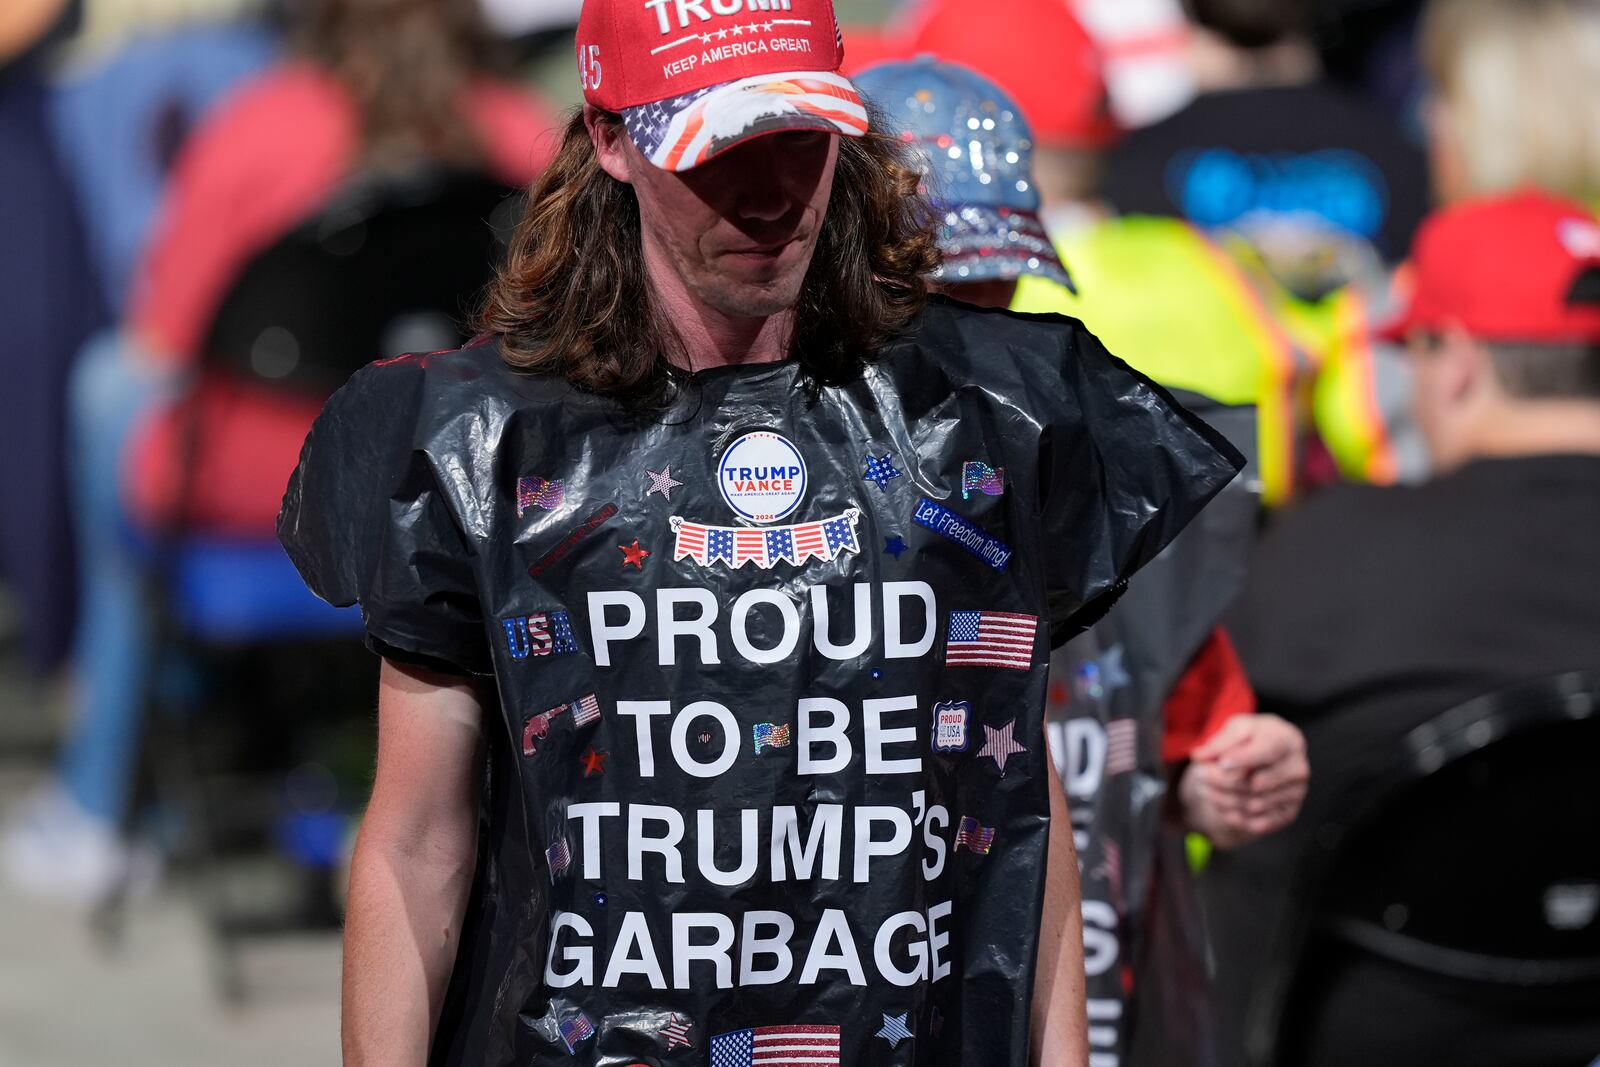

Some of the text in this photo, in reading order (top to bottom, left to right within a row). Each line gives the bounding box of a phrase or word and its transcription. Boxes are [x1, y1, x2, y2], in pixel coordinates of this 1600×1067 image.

[578, 44, 602, 90] 45
[663, 38, 811, 79] KEEP AMERICA GREAT!
[725, 466, 800, 481] TRUMP
[734, 480, 793, 492] VANCE
[915, 502, 1012, 567] Let Freedom Ring!
[501, 609, 578, 661] USA
[586, 580, 937, 668] PROUD
[616, 695, 922, 778] TO BE
[940, 714, 962, 724] PROUD
[946, 725, 961, 738] USA
[544, 900, 953, 990] GARBAGE
